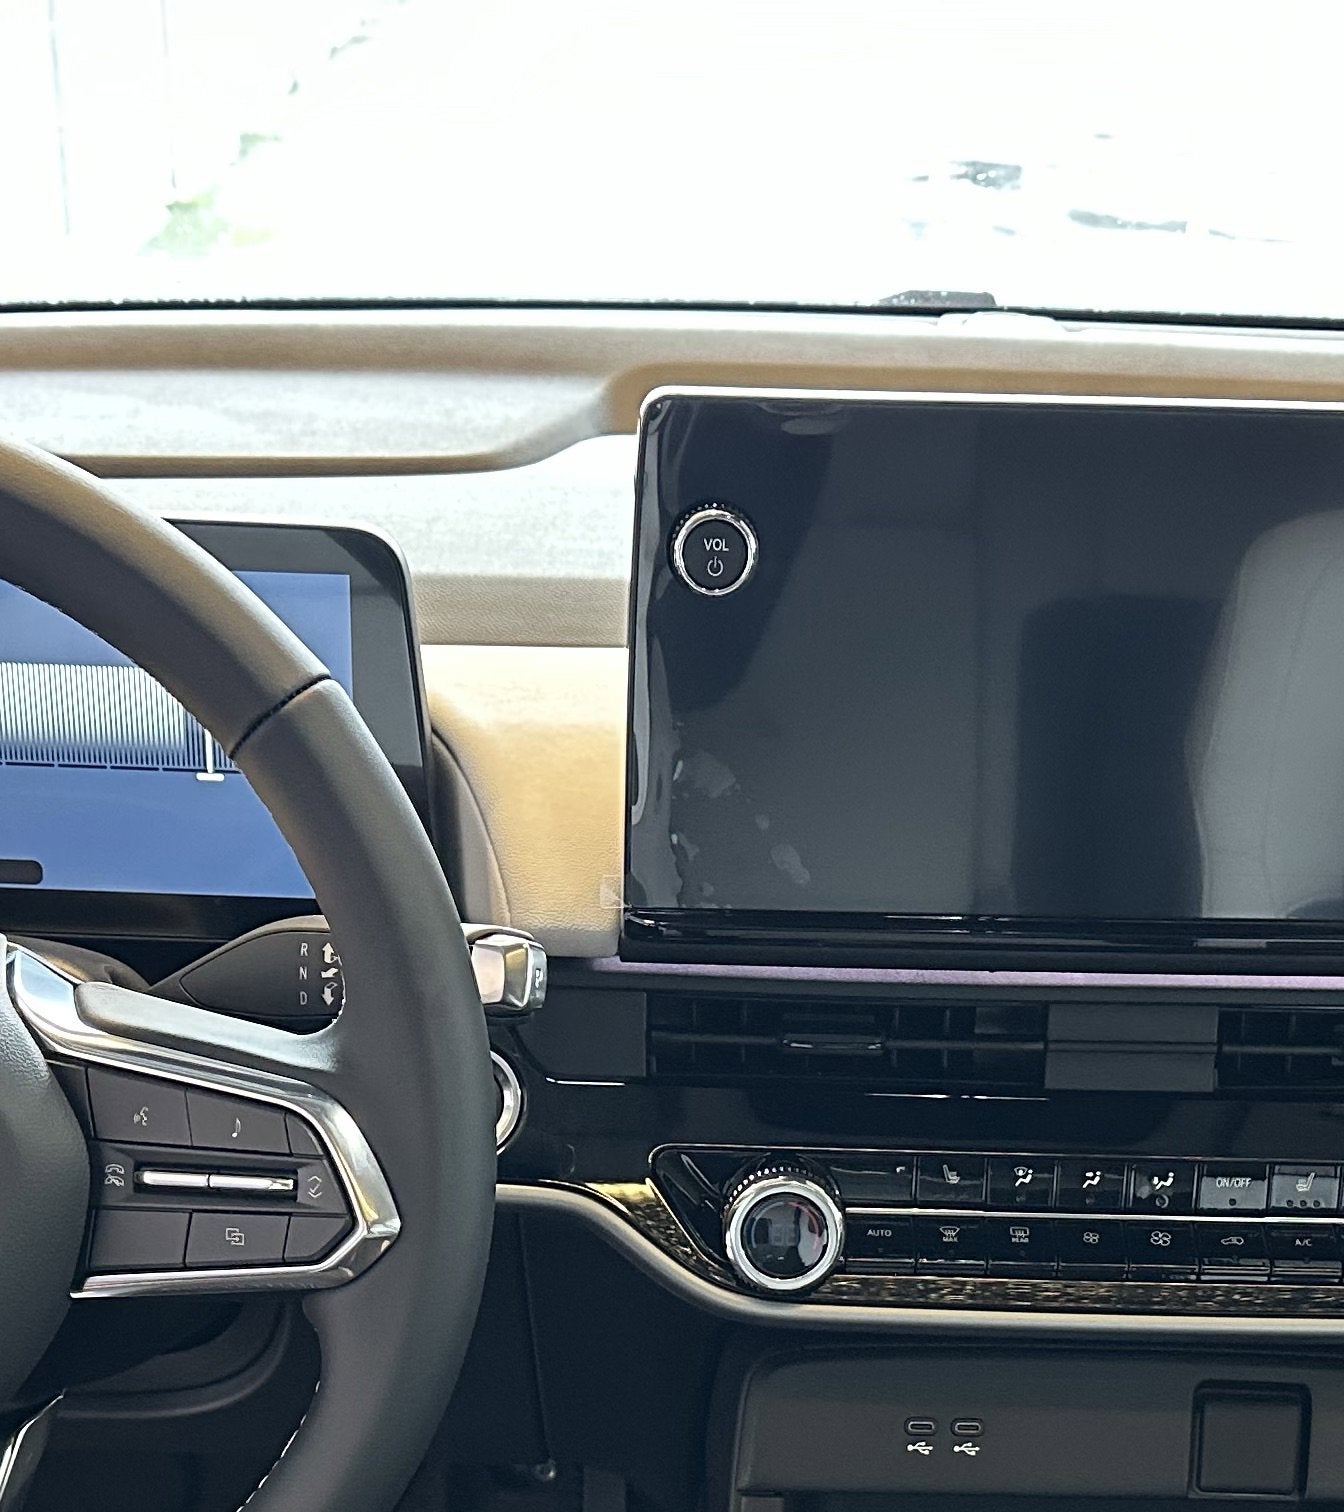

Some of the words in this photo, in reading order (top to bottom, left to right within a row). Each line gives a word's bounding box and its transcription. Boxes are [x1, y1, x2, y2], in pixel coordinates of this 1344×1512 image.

[704, 538, 729, 551] VOL
[299, 942, 309, 957] R
[299, 966, 308, 981] N
[299, 991, 309, 1006] D
[1215, 1176, 1252, 1188] ON/OFF
[866, 1229, 892, 1237] AUTO
[1294, 1238, 1312, 1247] A/C
